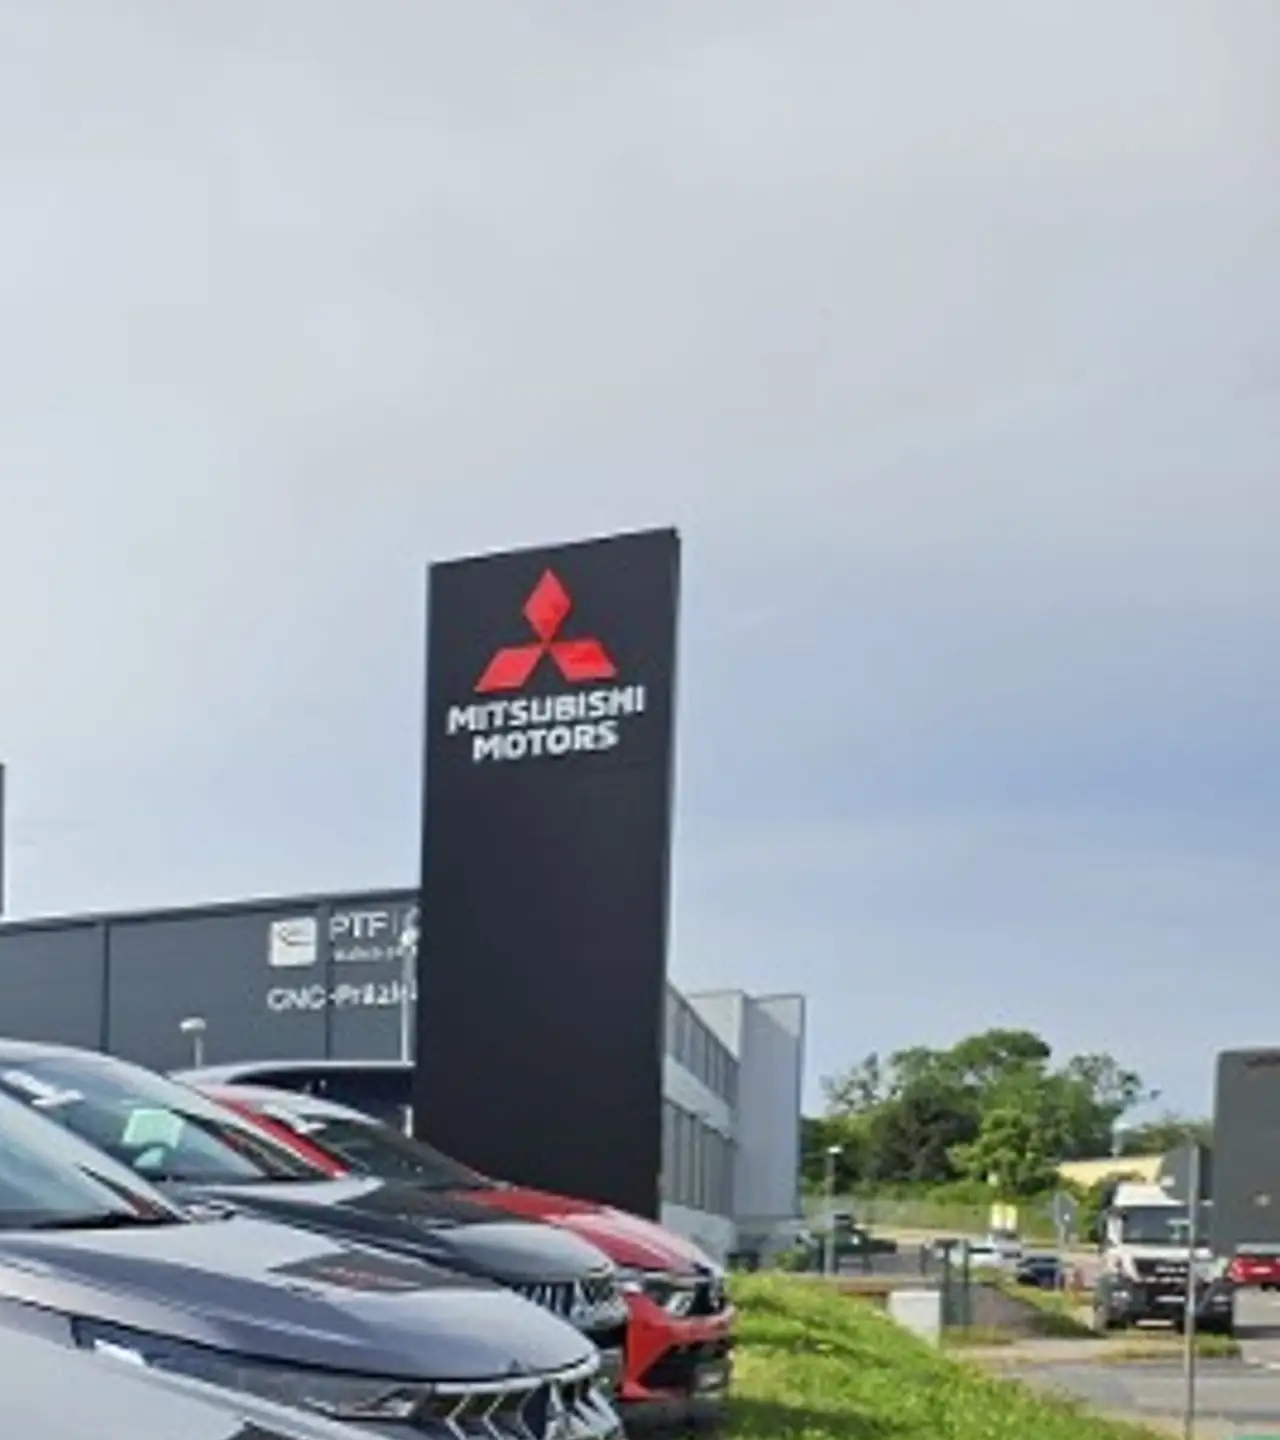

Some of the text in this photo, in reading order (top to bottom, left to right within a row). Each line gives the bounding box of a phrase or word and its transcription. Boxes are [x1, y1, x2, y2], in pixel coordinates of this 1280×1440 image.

[446, 684, 646, 736] MITSUBISHI
[472, 719, 620, 763] MOTORS
[328, 910, 390, 941] PTF
